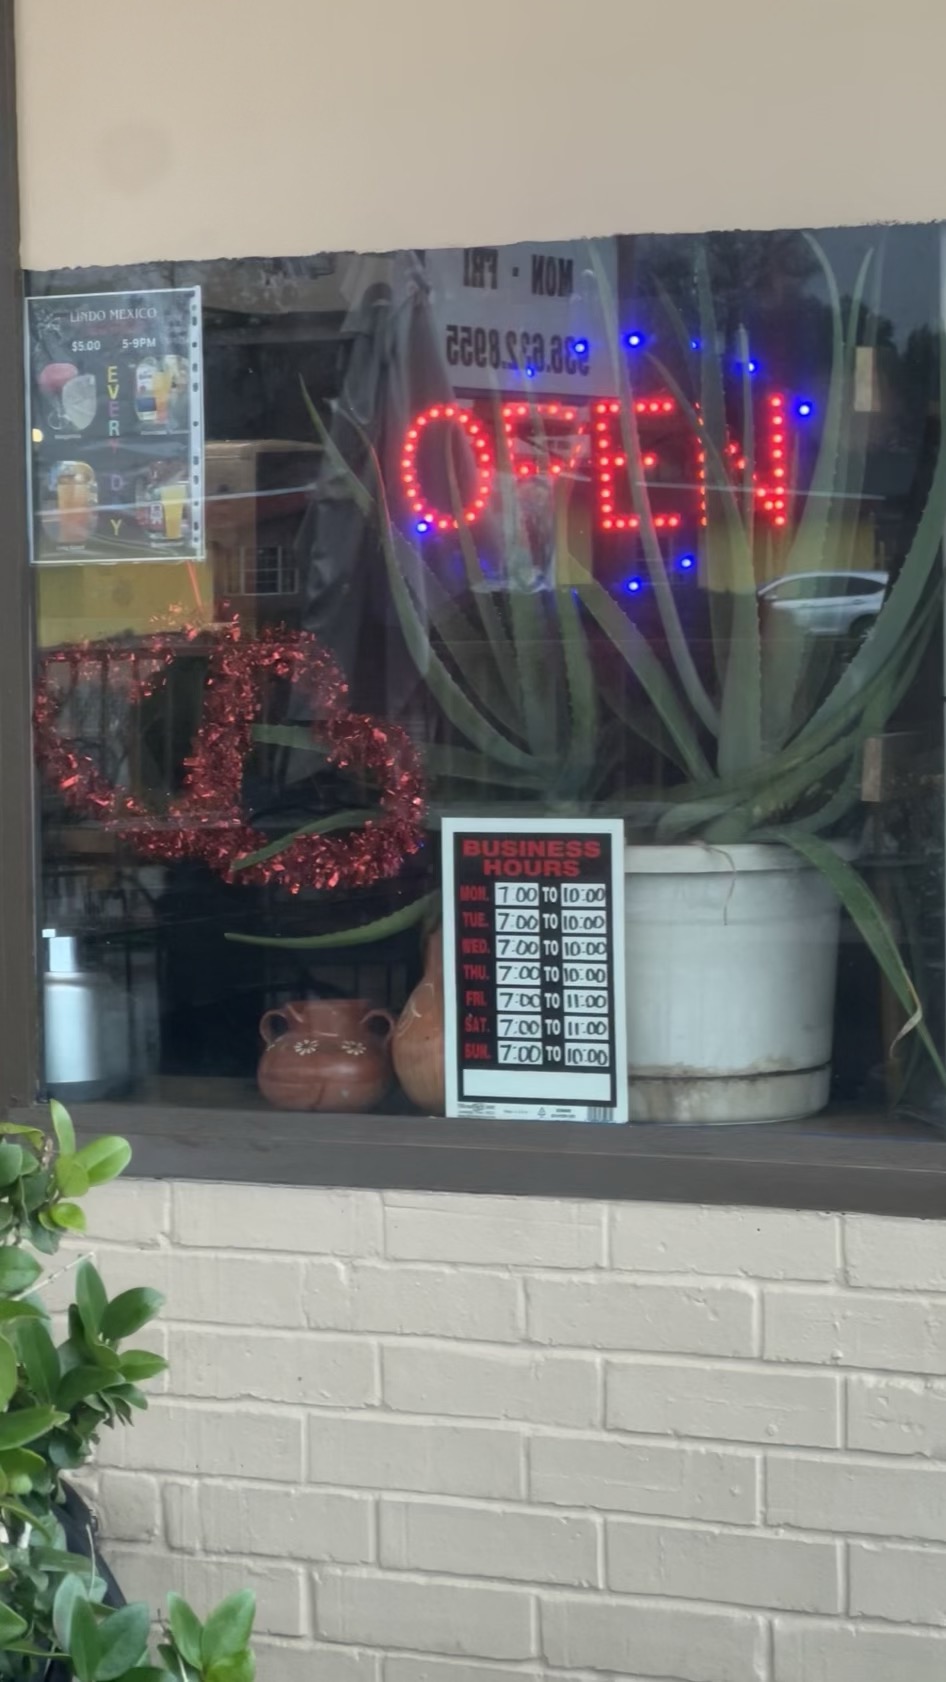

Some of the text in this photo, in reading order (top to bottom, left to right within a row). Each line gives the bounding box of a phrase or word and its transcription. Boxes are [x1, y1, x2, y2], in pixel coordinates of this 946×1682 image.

[70, 307, 157, 323] LINDO MEXICO
[72, 340, 101, 352] $5.00
[122, 338, 156, 349] 5-9PM
[402, 393, 787, 529] OPEN
[462, 839, 600, 858] BUSINESS
[483, 859, 580, 877] HOURS
[460, 885, 489, 902] MON.
[542, 887, 557, 902] TO
[462, 912, 489, 928] TUE.
[542, 914, 558, 929] TO
[462, 938, 490, 954] WED.
[543, 940, 559, 956] TO
[463, 964, 490, 980] THU.
[544, 966, 560, 982] TO
[465, 990, 487, 1006] FRI.
[544, 993, 560, 1008] TO
[464, 1017, 490, 1032] SAT.
[545, 1019, 561, 1035] TO
[464, 1043, 491, 1059] SUN.
[545, 1046, 562, 1061] TO
